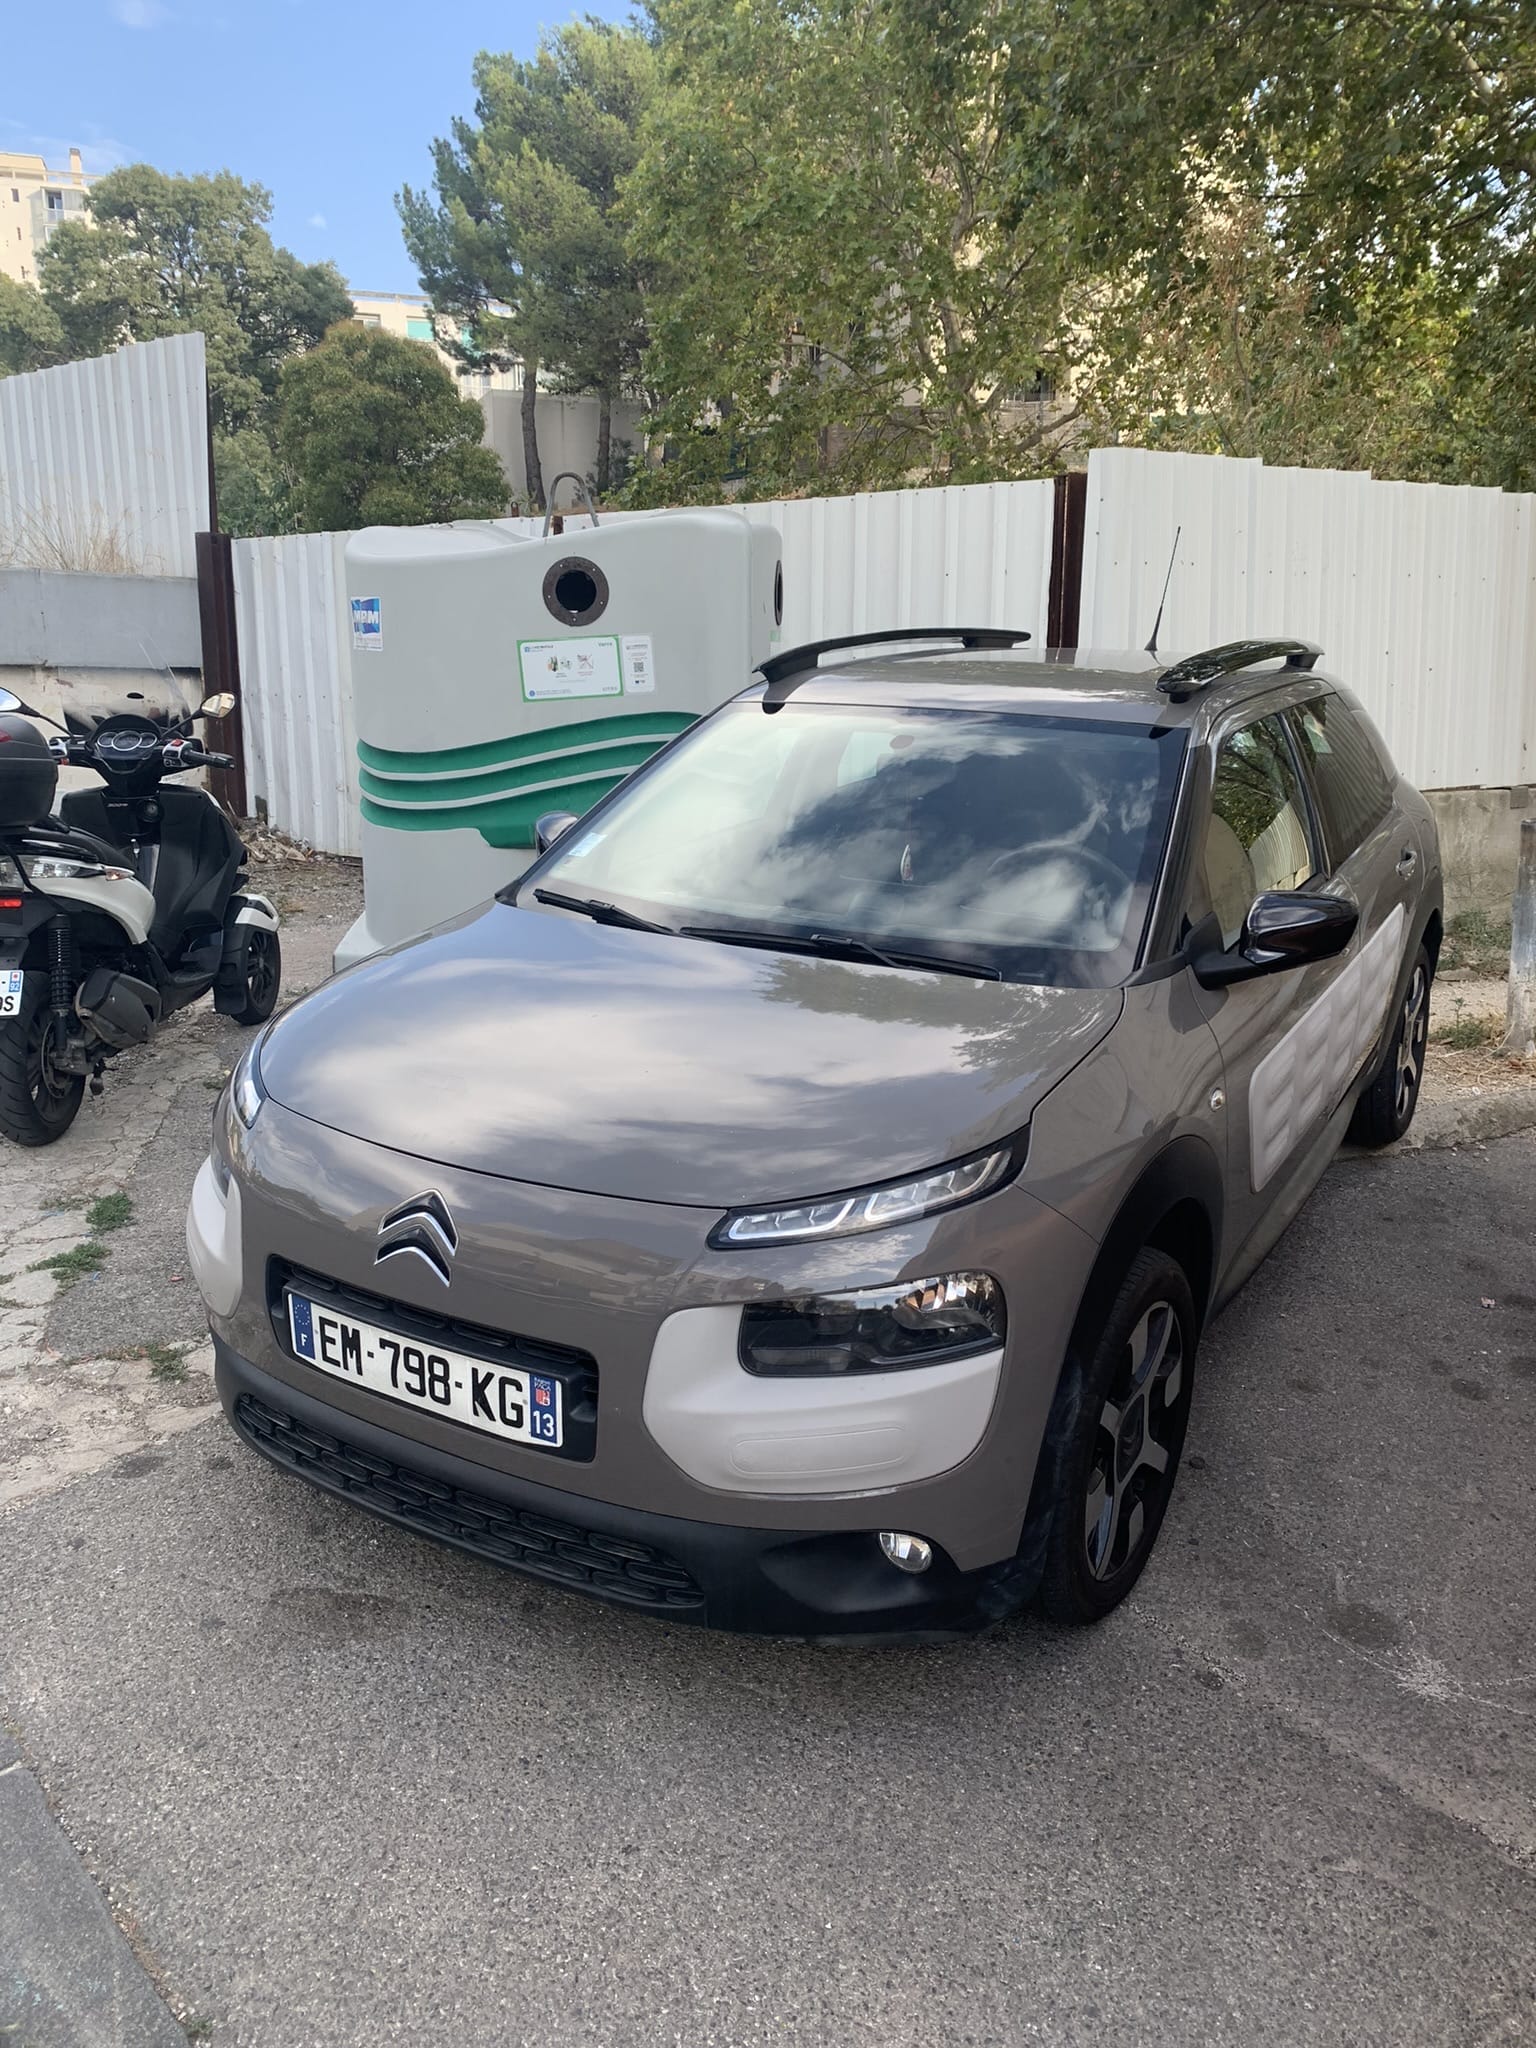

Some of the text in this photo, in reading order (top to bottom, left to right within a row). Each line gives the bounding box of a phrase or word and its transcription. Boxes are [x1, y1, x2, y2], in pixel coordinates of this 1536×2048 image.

[301, 1333, 308, 1347] F
[318, 1315, 524, 1429] EM-798-KG
[533, 1410, 555, 1437] 13
